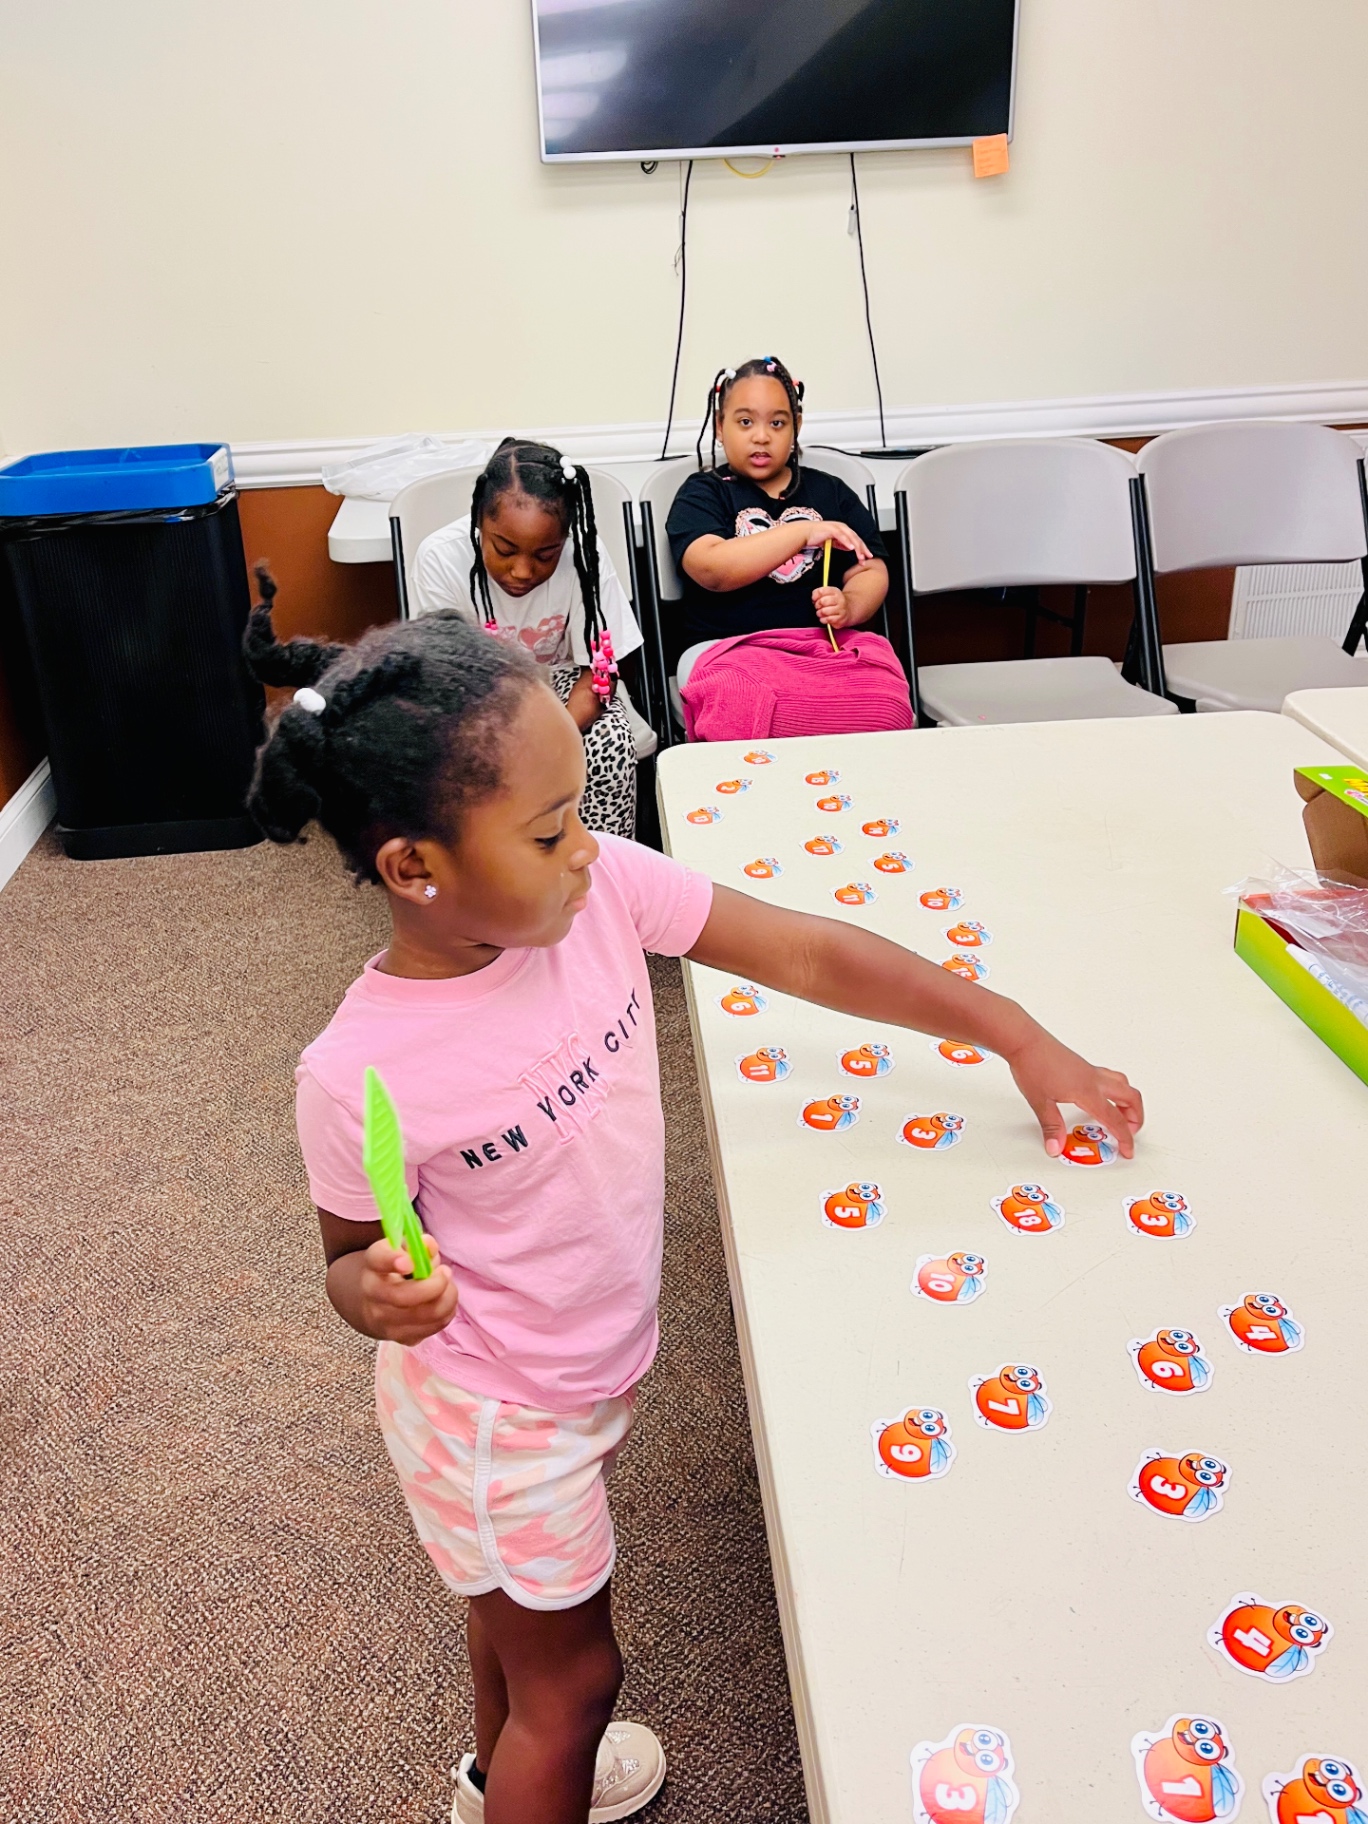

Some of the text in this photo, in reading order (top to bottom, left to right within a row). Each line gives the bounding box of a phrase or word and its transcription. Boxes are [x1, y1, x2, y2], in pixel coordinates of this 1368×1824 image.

[751, 868, 766, 876] 9
[881, 862, 900, 871] 5
[842, 894, 860, 903] 11
[926, 897, 945, 908] 10
[955, 934, 976, 944] 3
[731, 1001, 751, 1012] 6
[951, 1049, 975, 1060] 6
[748, 1064, 771, 1077] 11
[849, 1059, 872, 1070] 5
[460, 987, 641, 1170] NEW YORK CITY
[810, 1112, 834, 1123] 1
[911, 1127, 937, 1141] 3
[1068, 1145, 1096, 1159] 4
[833, 1205, 860, 1219] 5
[1012, 1207, 1042, 1227] 18
[1139, 1213, 1169, 1227] 3
[926, 1271, 954, 1293] 10
[1244, 1325, 1278, 1342] 4
[1151, 1359, 1185, 1379] 6
[987, 1397, 1020, 1417] 7
[890, 1443, 923, 1463] 9
[1151, 1475, 1187, 1501] 3
[1232, 1626, 1273, 1656] 4
[1161, 1777, 1203, 1797] 1
[934, 1782, 978, 1811] 3
